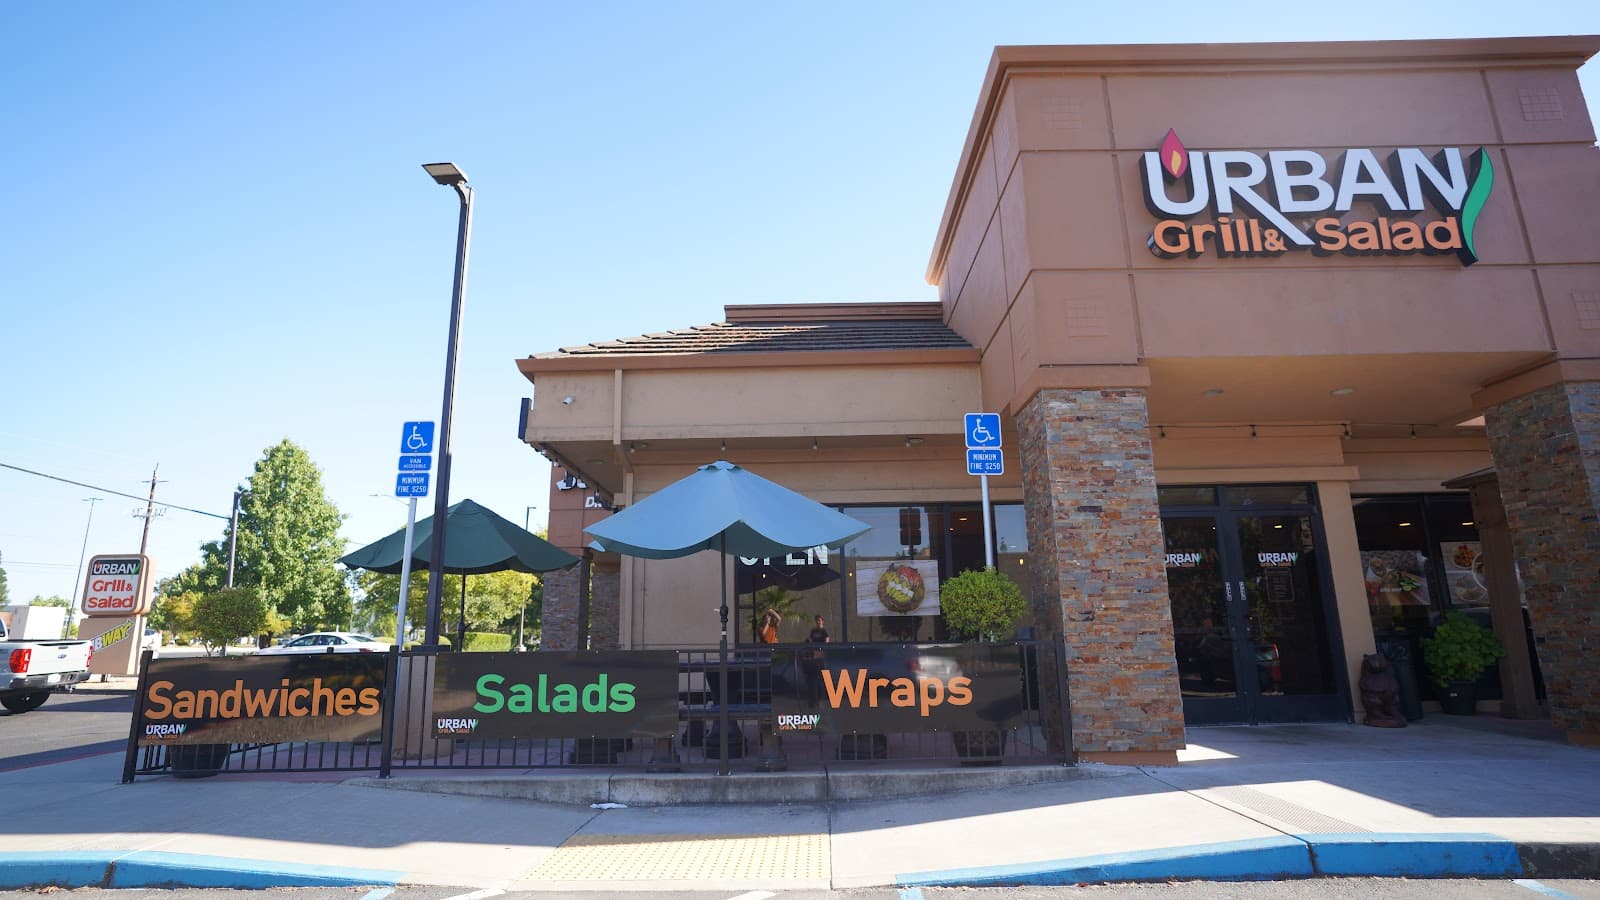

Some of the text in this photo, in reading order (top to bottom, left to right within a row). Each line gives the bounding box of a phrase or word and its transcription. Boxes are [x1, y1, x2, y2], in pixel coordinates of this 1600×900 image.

[1144, 147, 1469, 245] URBAN
[1314, 216, 1464, 251] Salad
[972, 453, 997, 461] MINIMUM
[1257, 552, 1297, 566] URBAN
[93, 563, 136, 575] URBAN
[88, 595, 134, 609] Salad
[91, 620, 132, 652] BWAY
[147, 678, 379, 718] Sandwiches
[475, 673, 636, 714] Salads
[822, 669, 973, 716] Wraps
[437, 718, 476, 733] URBAN
[777, 714, 818, 729] URBAN
[145, 723, 185, 738] URBAN
